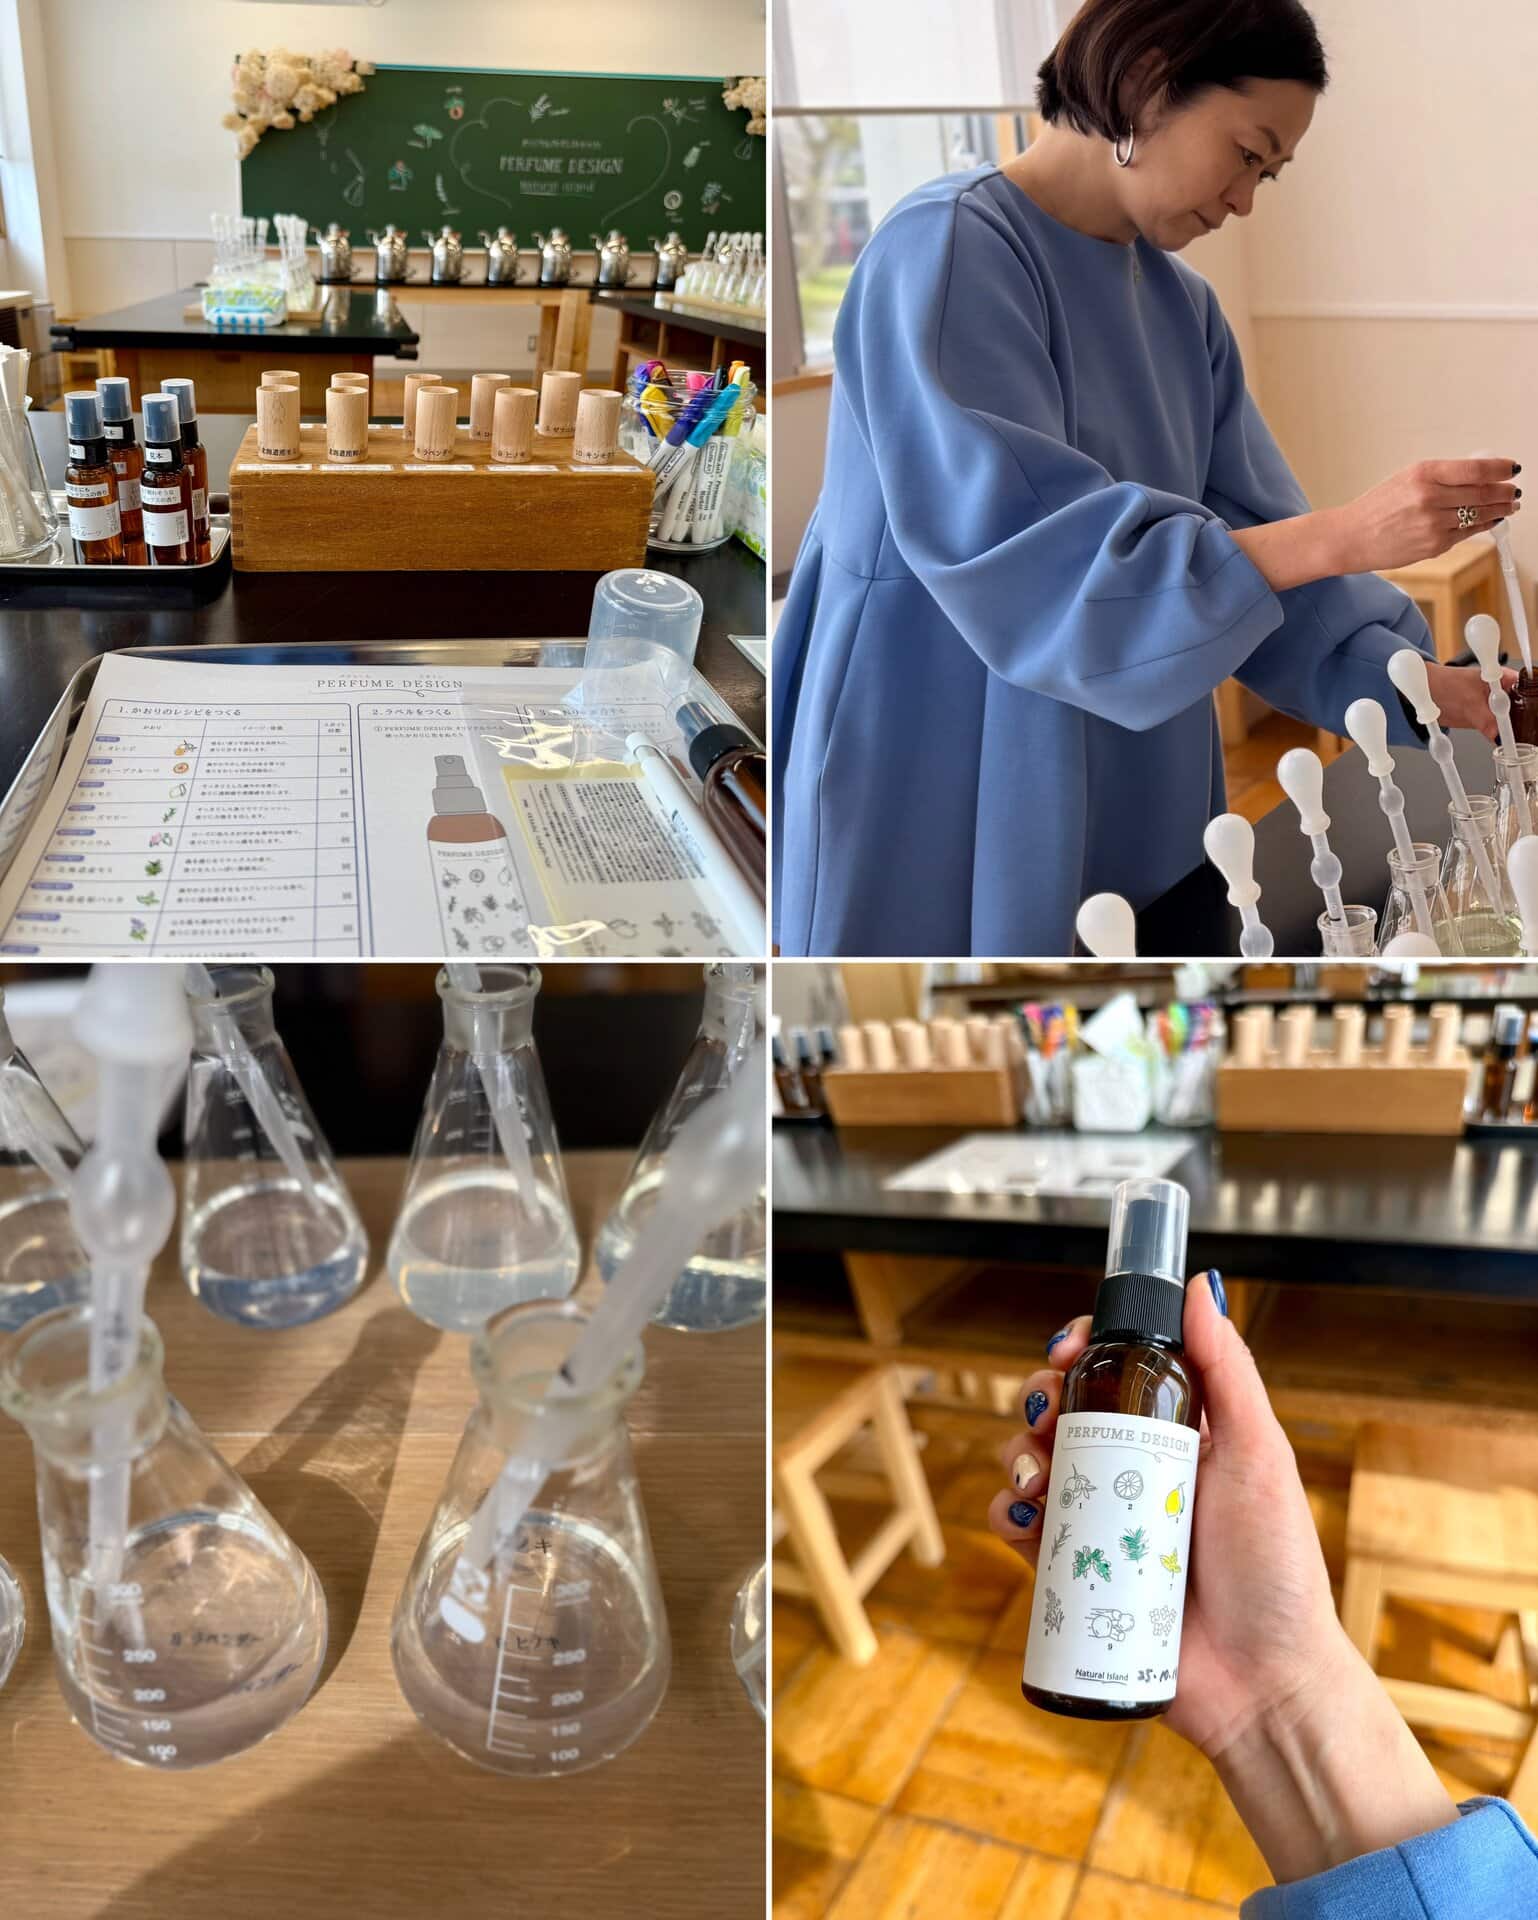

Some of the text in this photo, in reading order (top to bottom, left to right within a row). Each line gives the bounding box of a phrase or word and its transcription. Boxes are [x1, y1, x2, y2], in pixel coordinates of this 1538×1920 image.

[567, 156, 624, 175] DESIGN
[317, 680, 463, 688] PERFUME DESIGN
[1066, 1426, 1191, 1453] PERFUME DESIGN
[515, 1636, 560, 1649] ヒノキ
[122, 1649, 157, 1663] 250
[552, 1649, 587, 1666] 250
[1075, 1668, 1129, 1681] Natural Island
[133, 1688, 166, 1702] 200
[551, 1690, 584, 1707] 200
[142, 1719, 171, 1732] 150
[552, 1721, 581, 1737] 150
[148, 1744, 177, 1757] 100
[550, 1748, 579, 1762] 100
